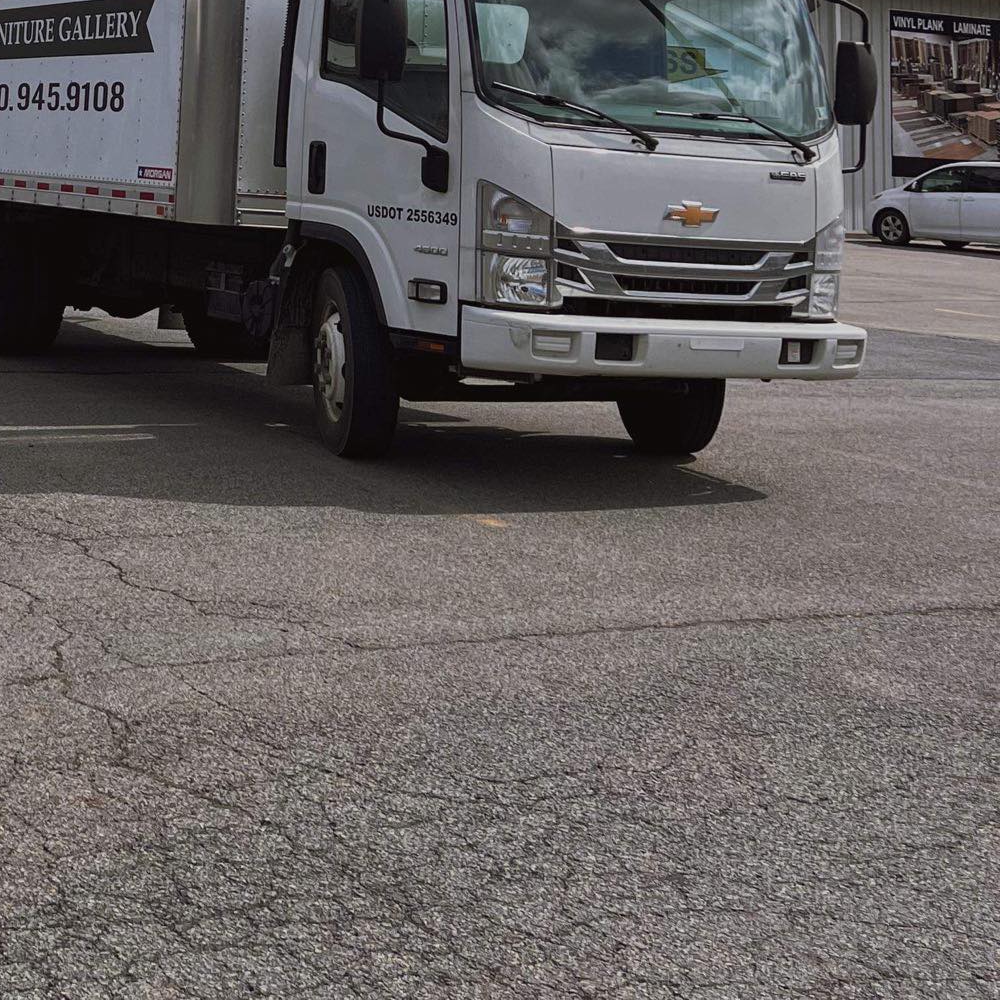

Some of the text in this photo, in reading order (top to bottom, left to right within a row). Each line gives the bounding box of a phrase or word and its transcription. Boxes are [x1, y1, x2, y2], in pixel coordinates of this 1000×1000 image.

[59, 10, 142, 42] GALLERY
[893, 15, 944, 32] VINYL PLANK
[953, 22, 991, 36] LAMINATE
[144, 168, 172, 180] MORGAN
[367, 205, 458, 226] USDOT 2556349
